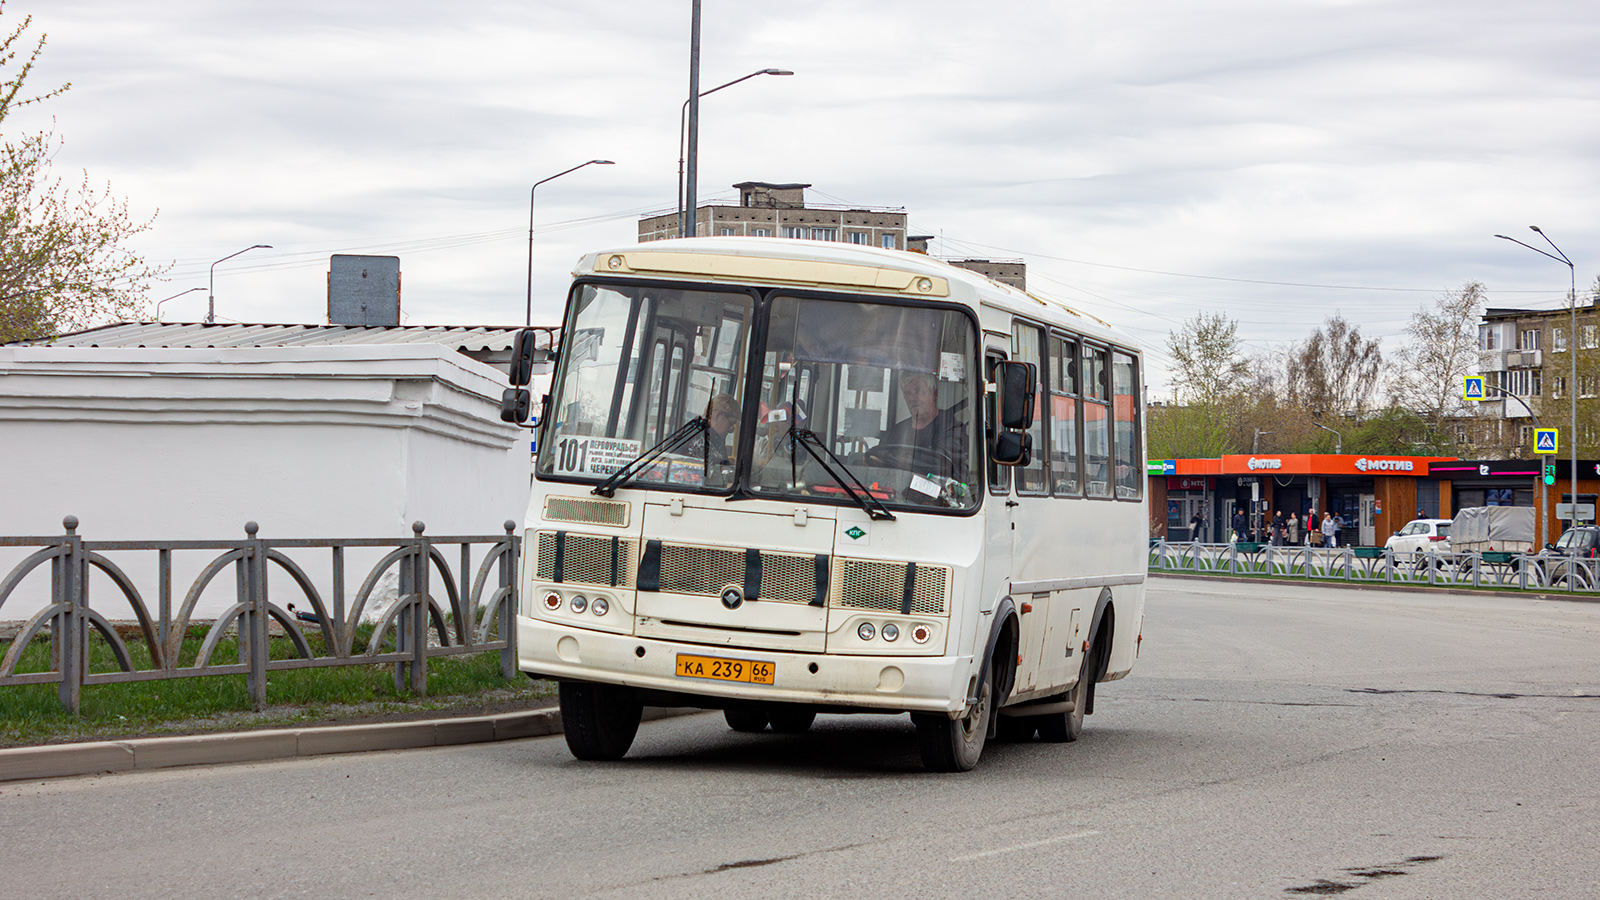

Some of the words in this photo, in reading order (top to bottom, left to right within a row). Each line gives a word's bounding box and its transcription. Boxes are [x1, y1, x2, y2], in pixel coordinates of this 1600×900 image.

[558, 438, 589, 472] 101
[1367, 460, 1414, 471] МОТИВ
[684, 661, 704, 675] КА
[711, 660, 743, 679] 239
[752, 663, 769, 677] 66
